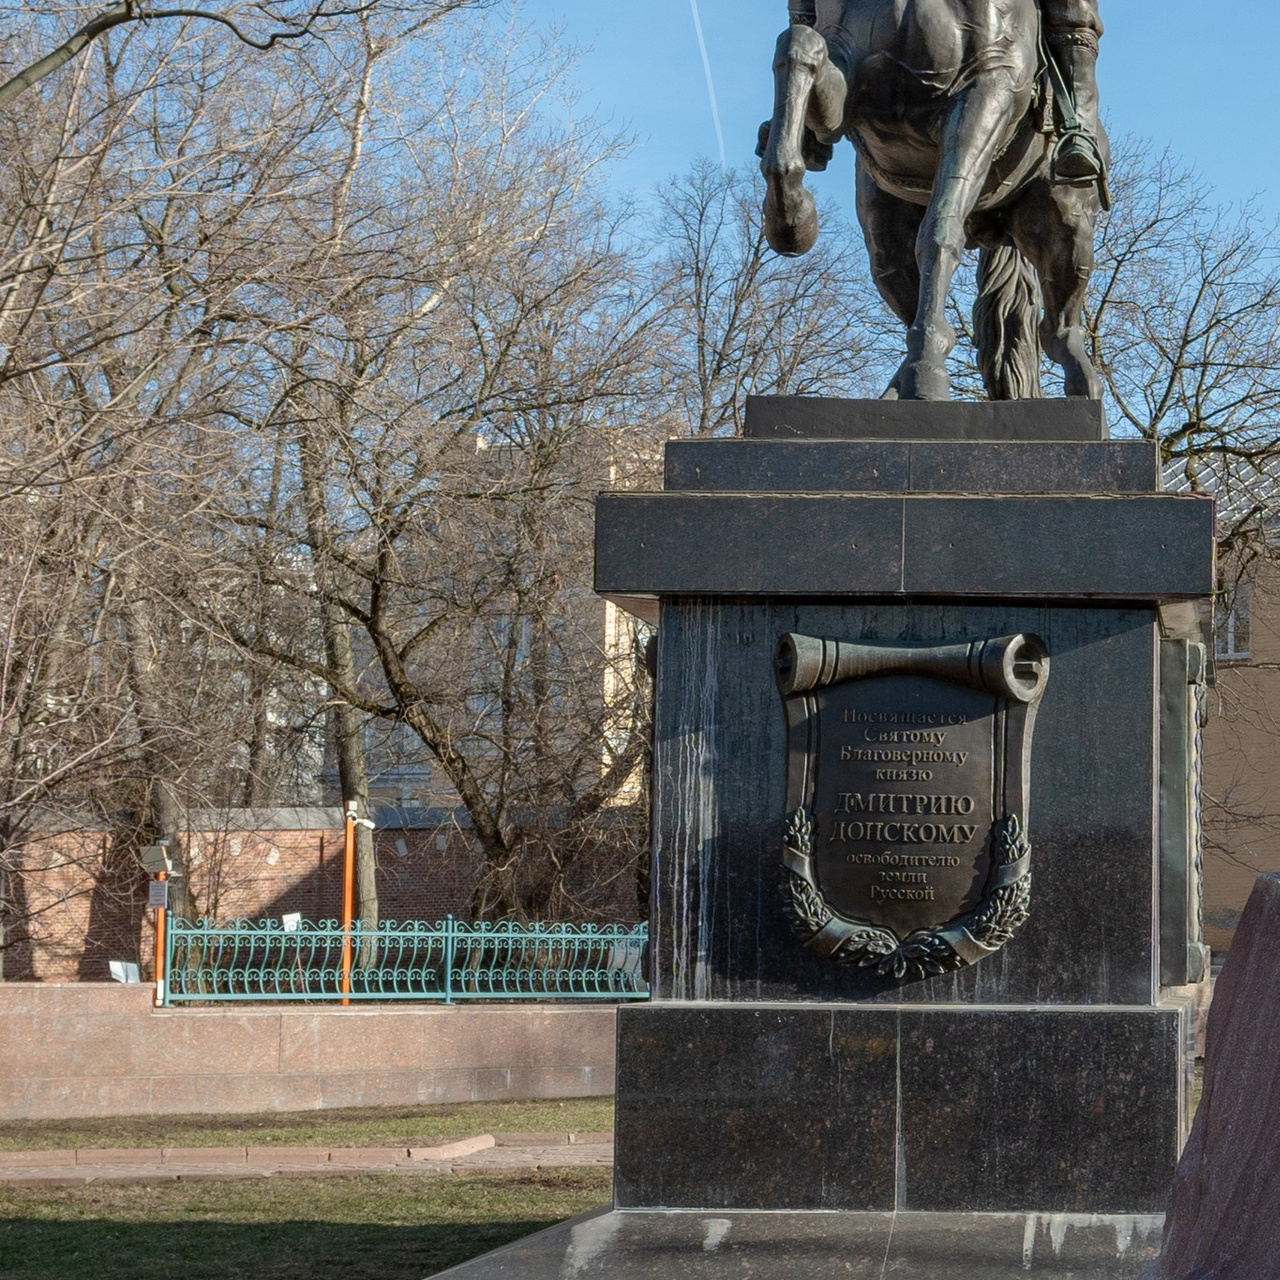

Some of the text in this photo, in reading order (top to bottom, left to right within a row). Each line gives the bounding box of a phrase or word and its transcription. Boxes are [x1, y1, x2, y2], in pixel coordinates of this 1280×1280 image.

[843, 708, 968, 726] Посвящается
[863, 727, 948, 747] Святому
[840, 745, 970, 767] Благоверному
[875, 769, 933, 783] князю
[833, 792, 975, 816] ДМИТРИЮ
[829, 821, 980, 845] ДОНСКОМУ
[846, 853, 961, 869] освободителю
[877, 871, 928, 885] земли
[870, 884, 936, 904] Русской
